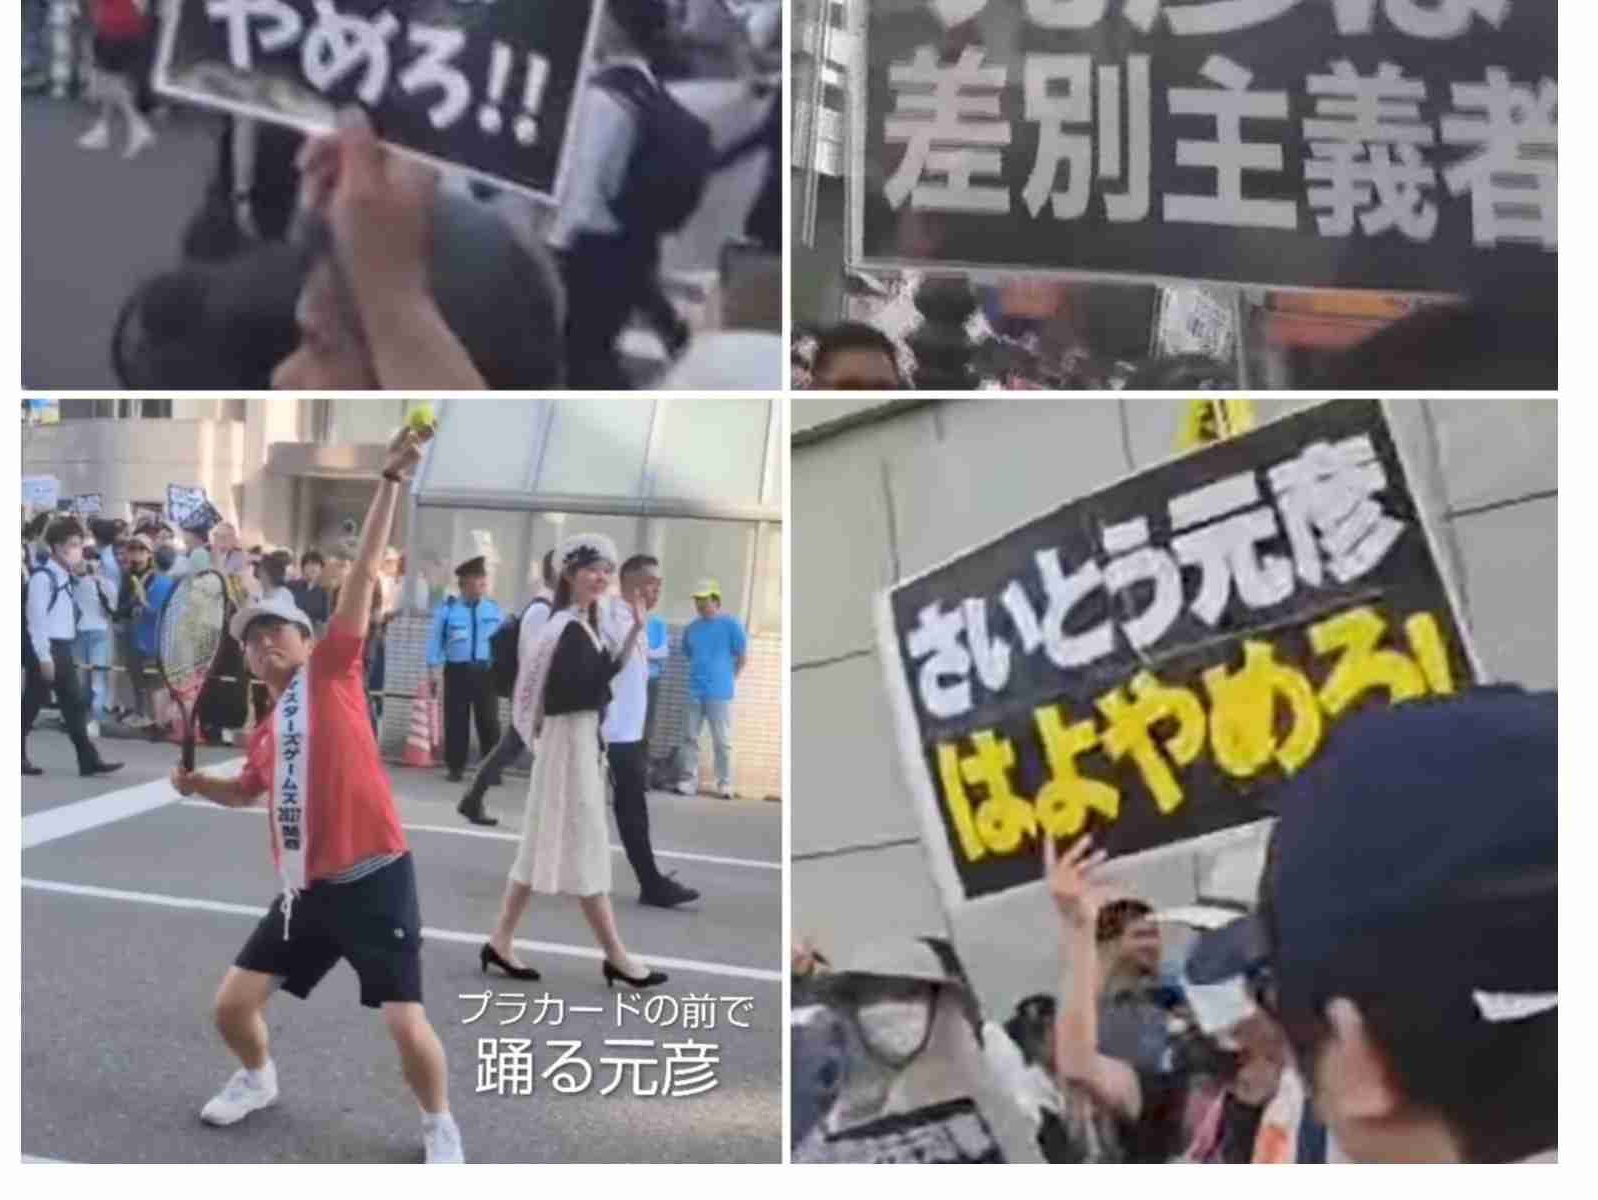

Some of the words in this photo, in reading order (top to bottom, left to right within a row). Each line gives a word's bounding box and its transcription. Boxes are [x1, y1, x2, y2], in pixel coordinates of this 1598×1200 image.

[881, 42, 1558, 252] 差別主義者
[907, 432, 1406, 719] さいとう元彦
